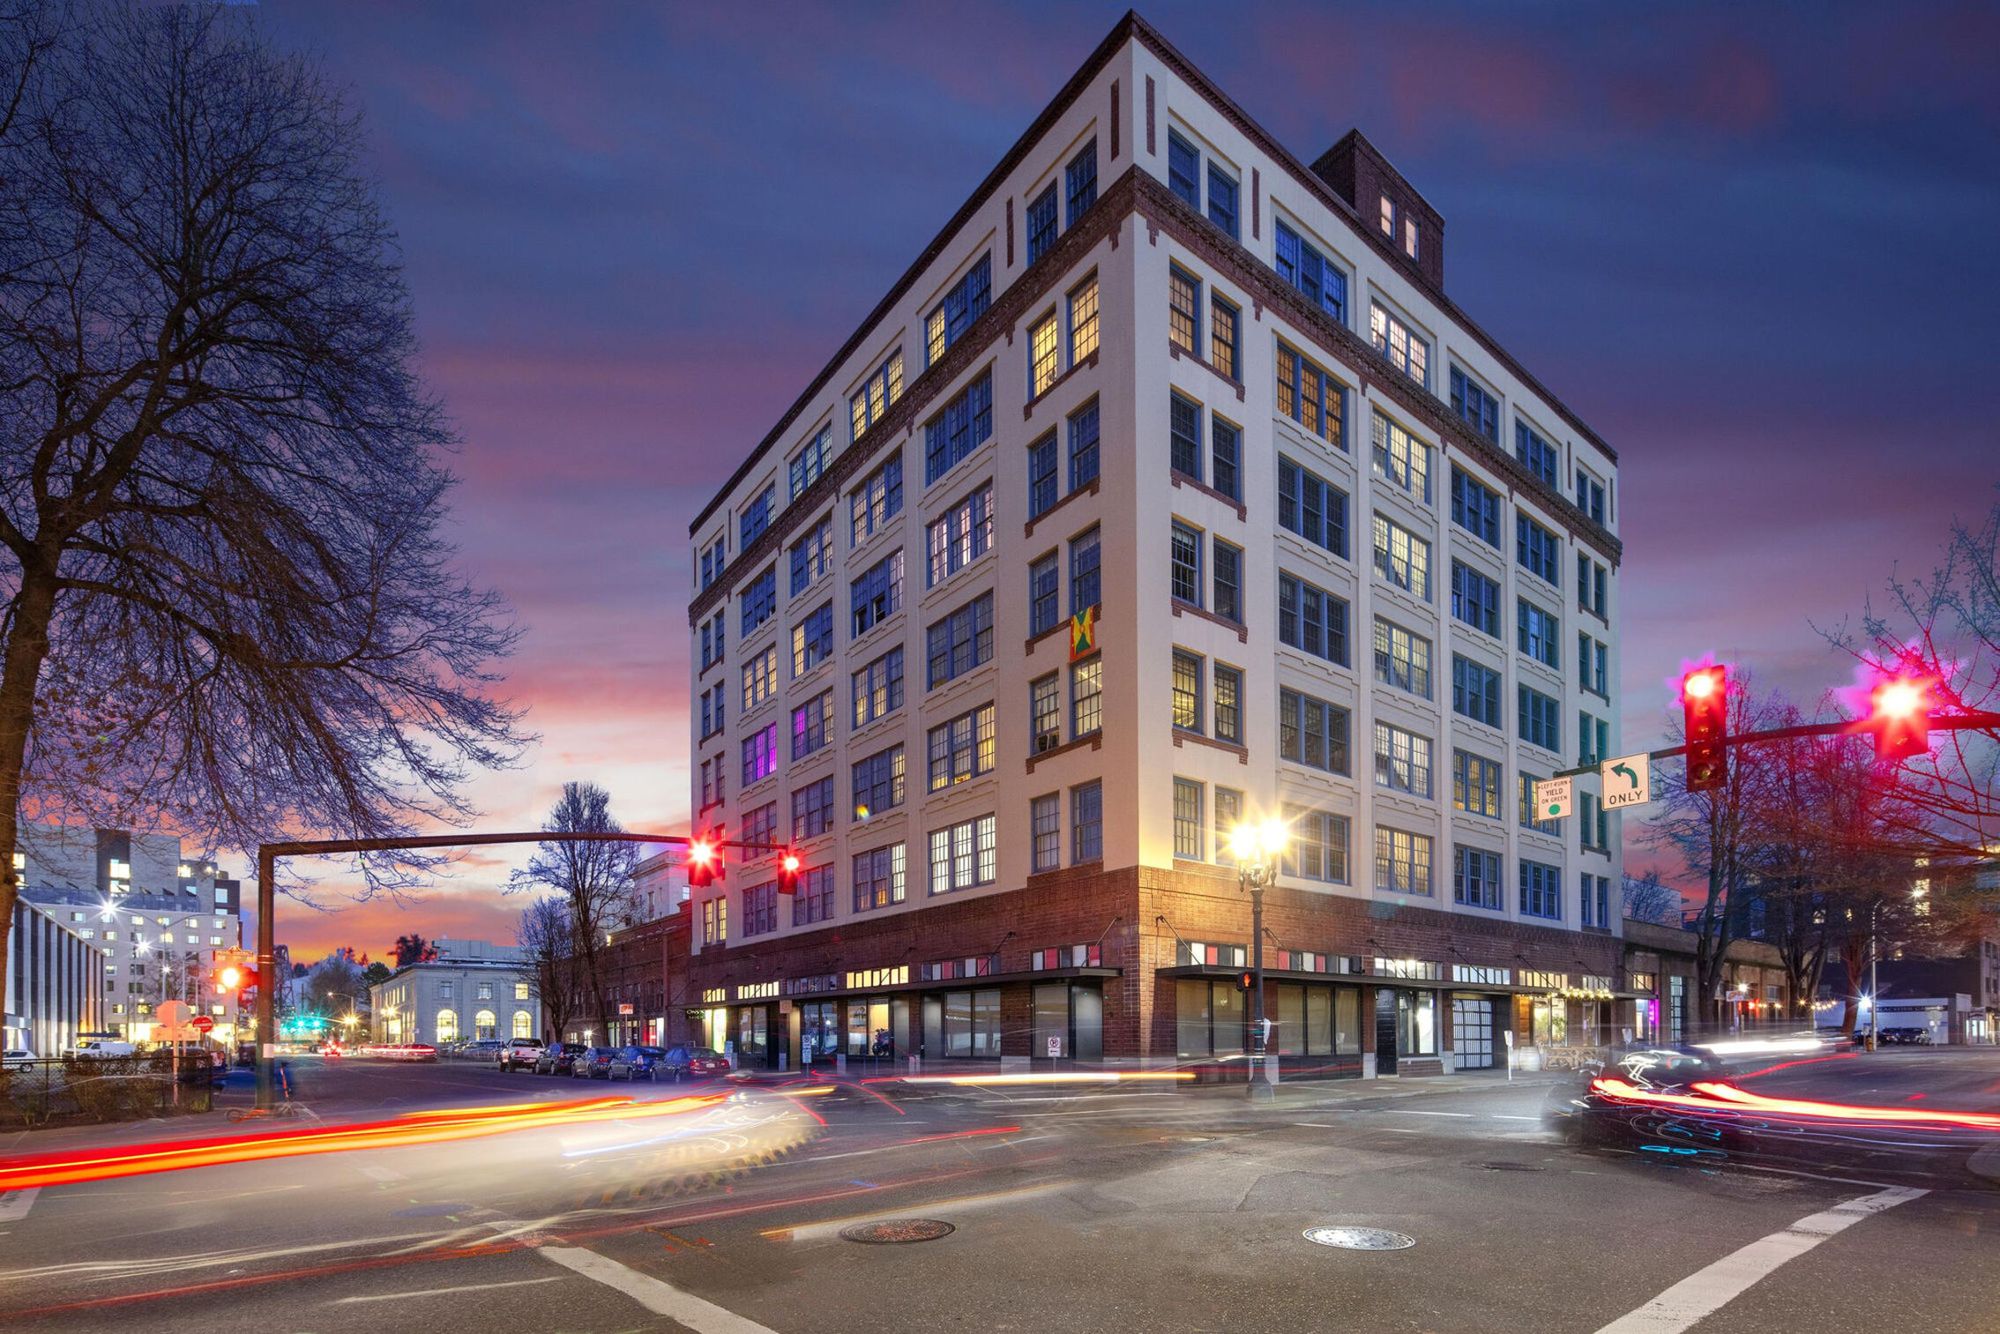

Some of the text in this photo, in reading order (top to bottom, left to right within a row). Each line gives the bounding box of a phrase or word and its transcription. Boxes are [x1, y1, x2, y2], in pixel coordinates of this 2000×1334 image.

[1540, 782, 1553, 790] LEFT
[1545, 787, 1564, 797] YIELD
[1550, 795, 1568, 803] GREEN
[1609, 790, 1643, 805] ONLY
